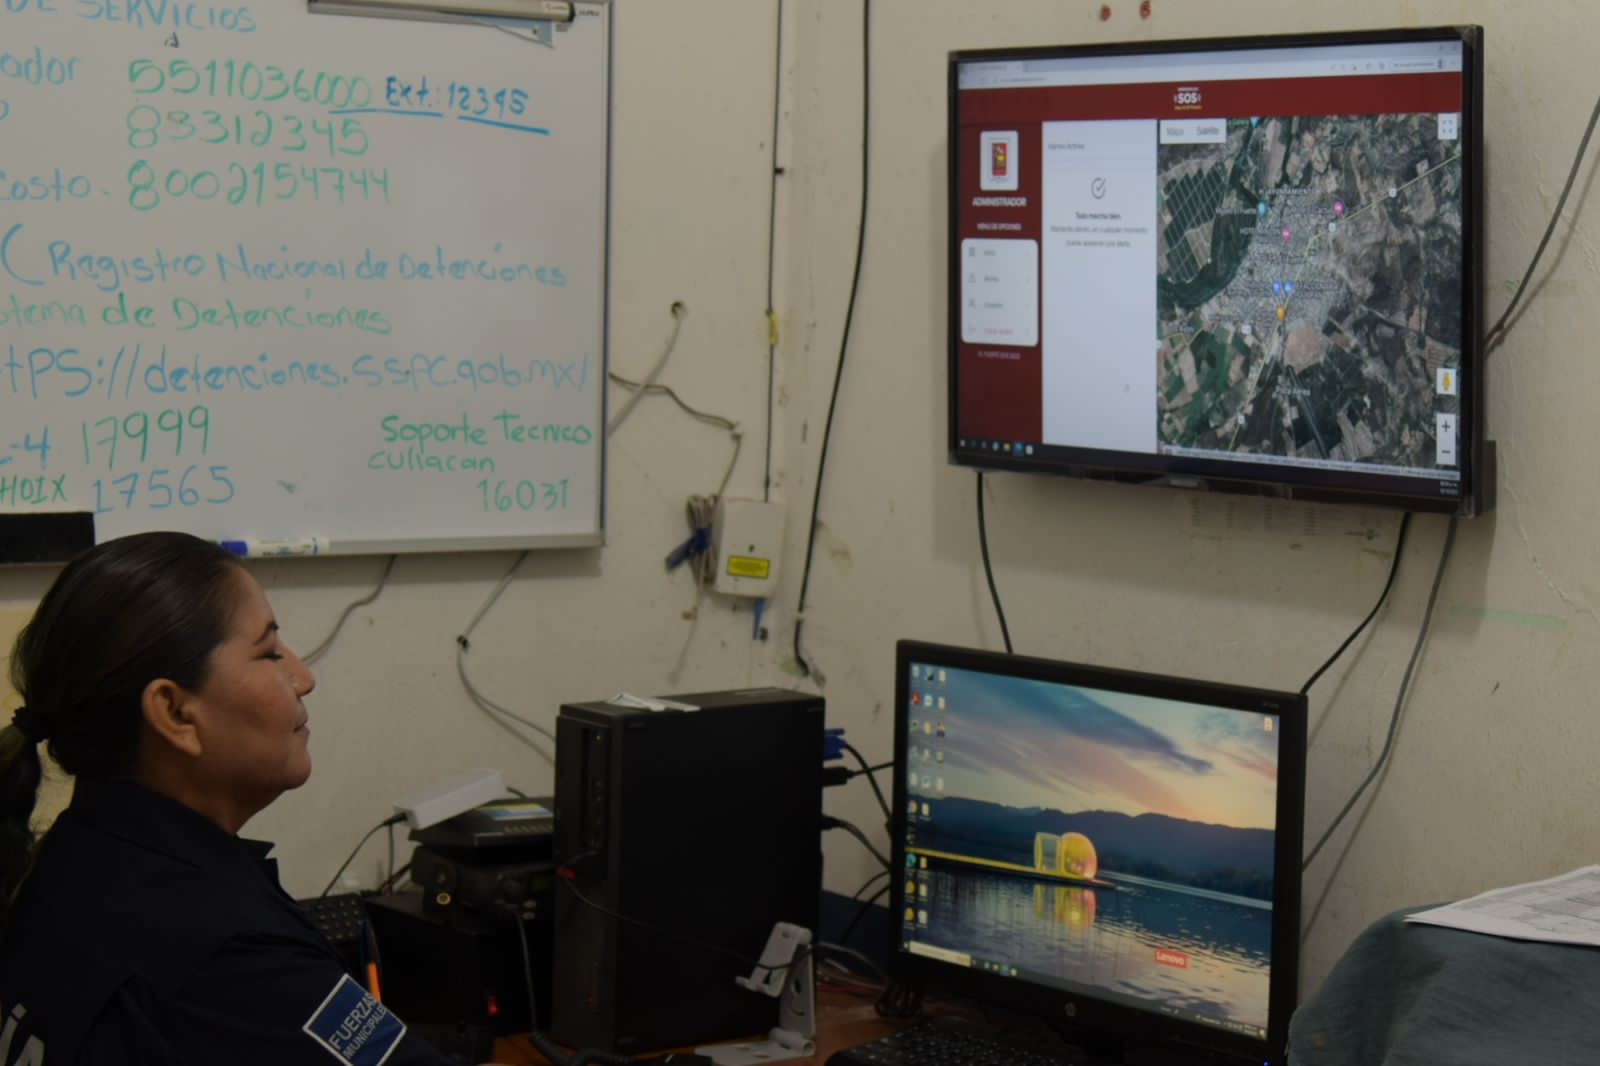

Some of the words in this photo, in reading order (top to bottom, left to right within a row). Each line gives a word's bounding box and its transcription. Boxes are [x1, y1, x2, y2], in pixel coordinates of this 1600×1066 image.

[101, 291, 156, 327] de
[81, 404, 210, 470] 17999
[380, 411, 489, 455] Soporte
[91, 464, 236, 515] 17565
[477, 478, 569, 512] 16031
